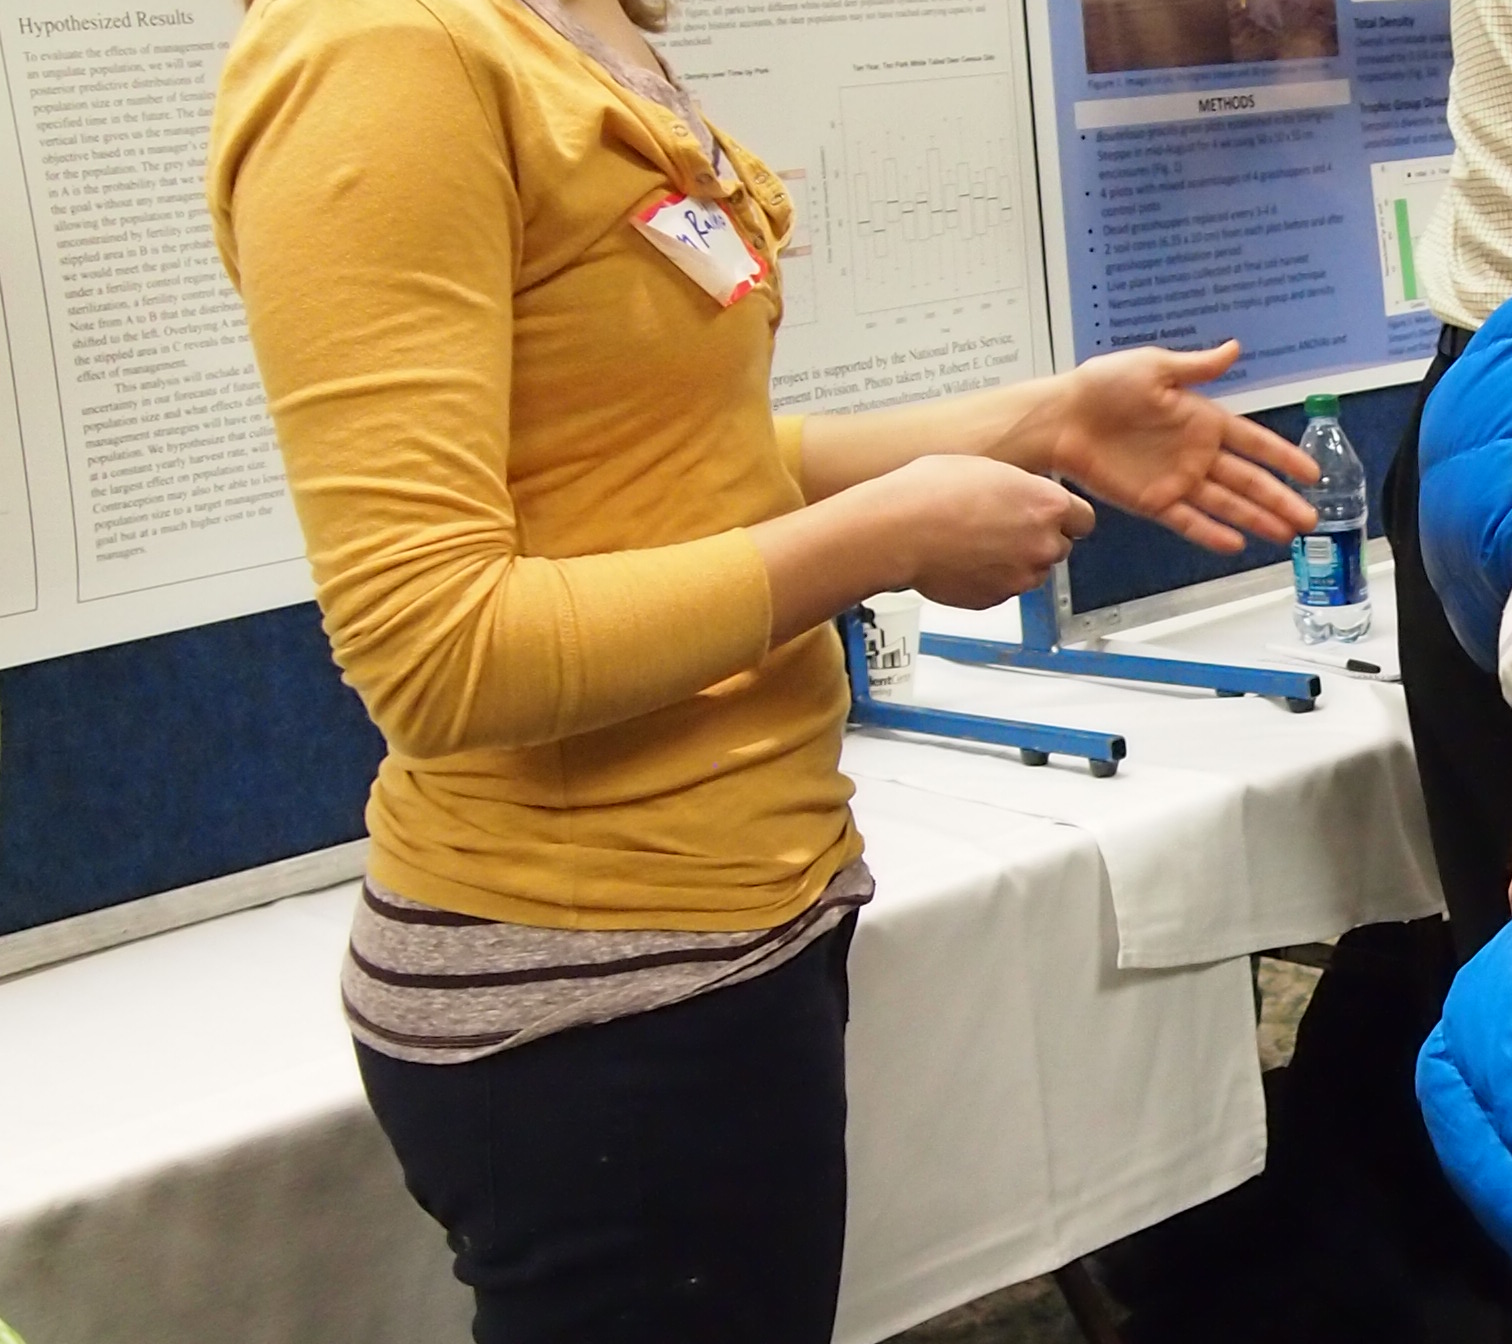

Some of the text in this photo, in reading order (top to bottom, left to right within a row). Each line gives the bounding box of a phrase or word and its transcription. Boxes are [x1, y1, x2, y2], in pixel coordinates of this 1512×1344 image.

[18, 9, 194, 37] Hypothesized Results
[1198, 94, 1255, 112] METHODS
